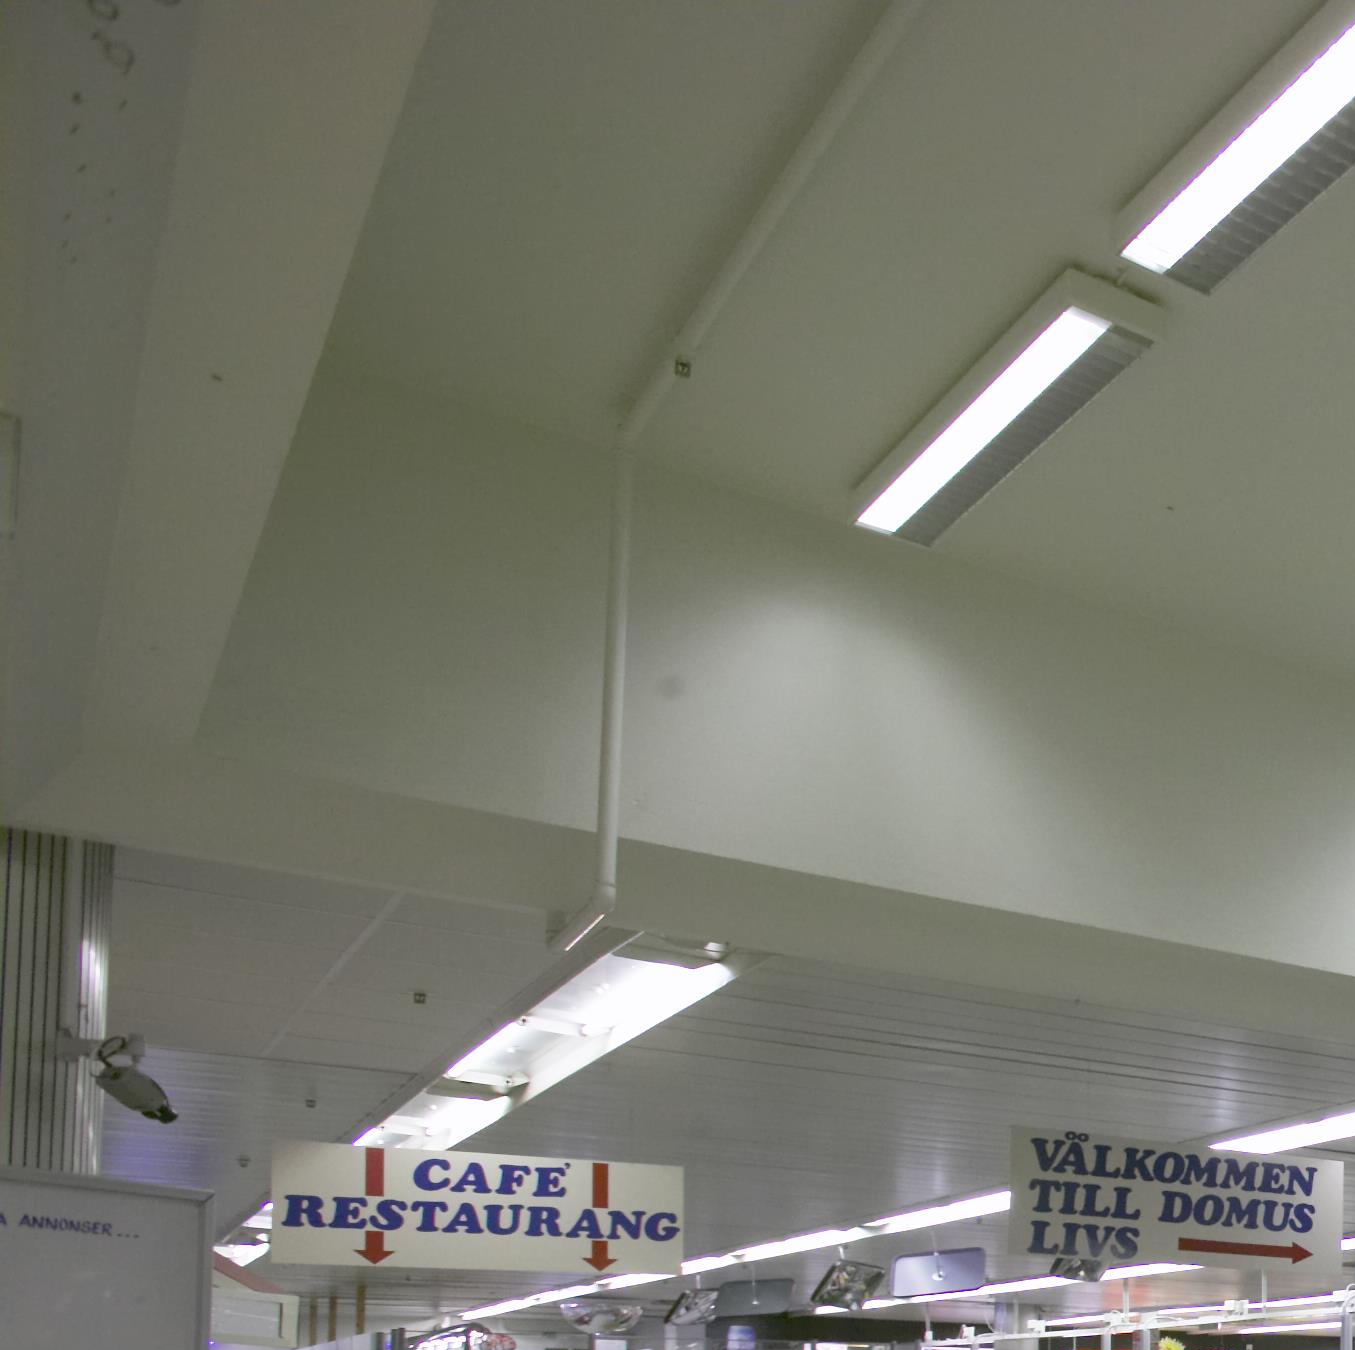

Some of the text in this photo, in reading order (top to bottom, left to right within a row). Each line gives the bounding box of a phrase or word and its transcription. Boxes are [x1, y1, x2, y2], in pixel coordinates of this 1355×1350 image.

[1030, 1131, 1318, 1197] VÄLKOMMEN
[281, 1194, 680, 1242] RESTAURANG
[1029, 1178, 1316, 1233] TILL DOMUS
[1027, 1220, 1140, 1260] LIVS
